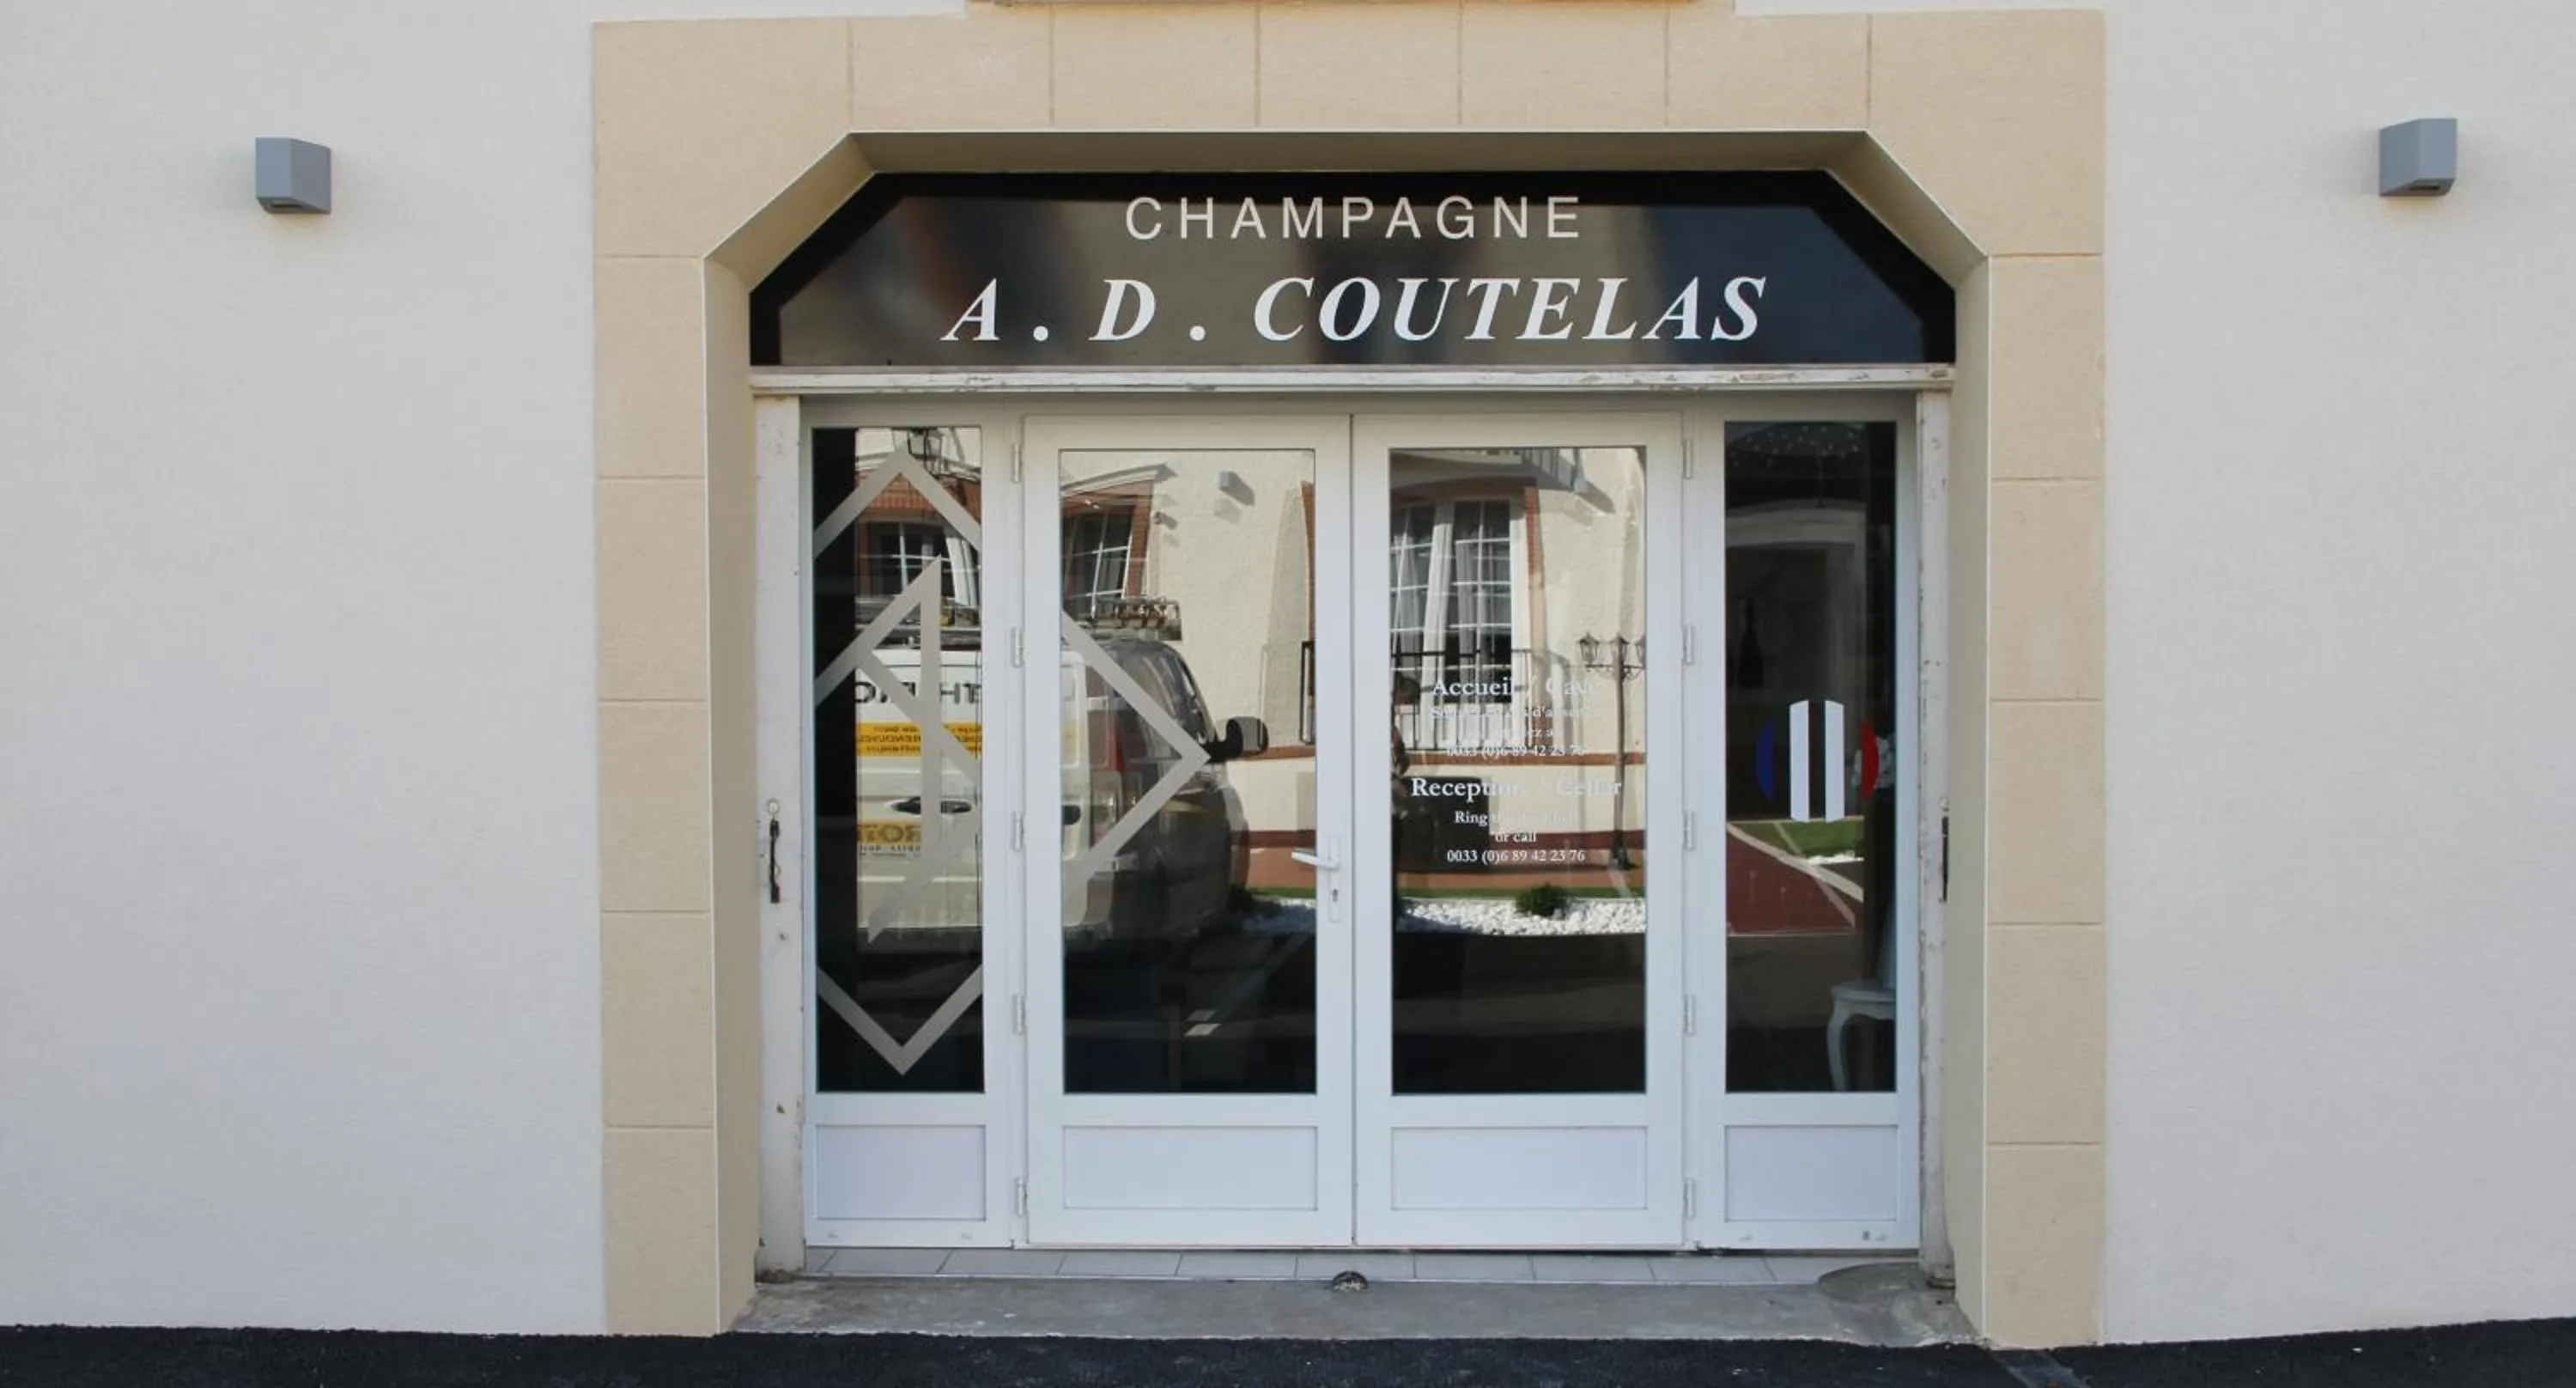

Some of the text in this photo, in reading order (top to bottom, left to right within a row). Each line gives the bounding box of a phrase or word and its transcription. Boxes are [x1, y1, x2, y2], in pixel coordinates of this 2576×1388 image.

[1126, 198, 1580, 240] CHAMPAGNE
[1254, 277, 1766, 342] COUTELAS
[1432, 676, 1516, 697] Accueil
[1455, 810, 1488, 827] Ring
[1495, 831, 1536, 843] or call
[1446, 849, 1586, 865] 0033 (0)6 89 42 23 76
